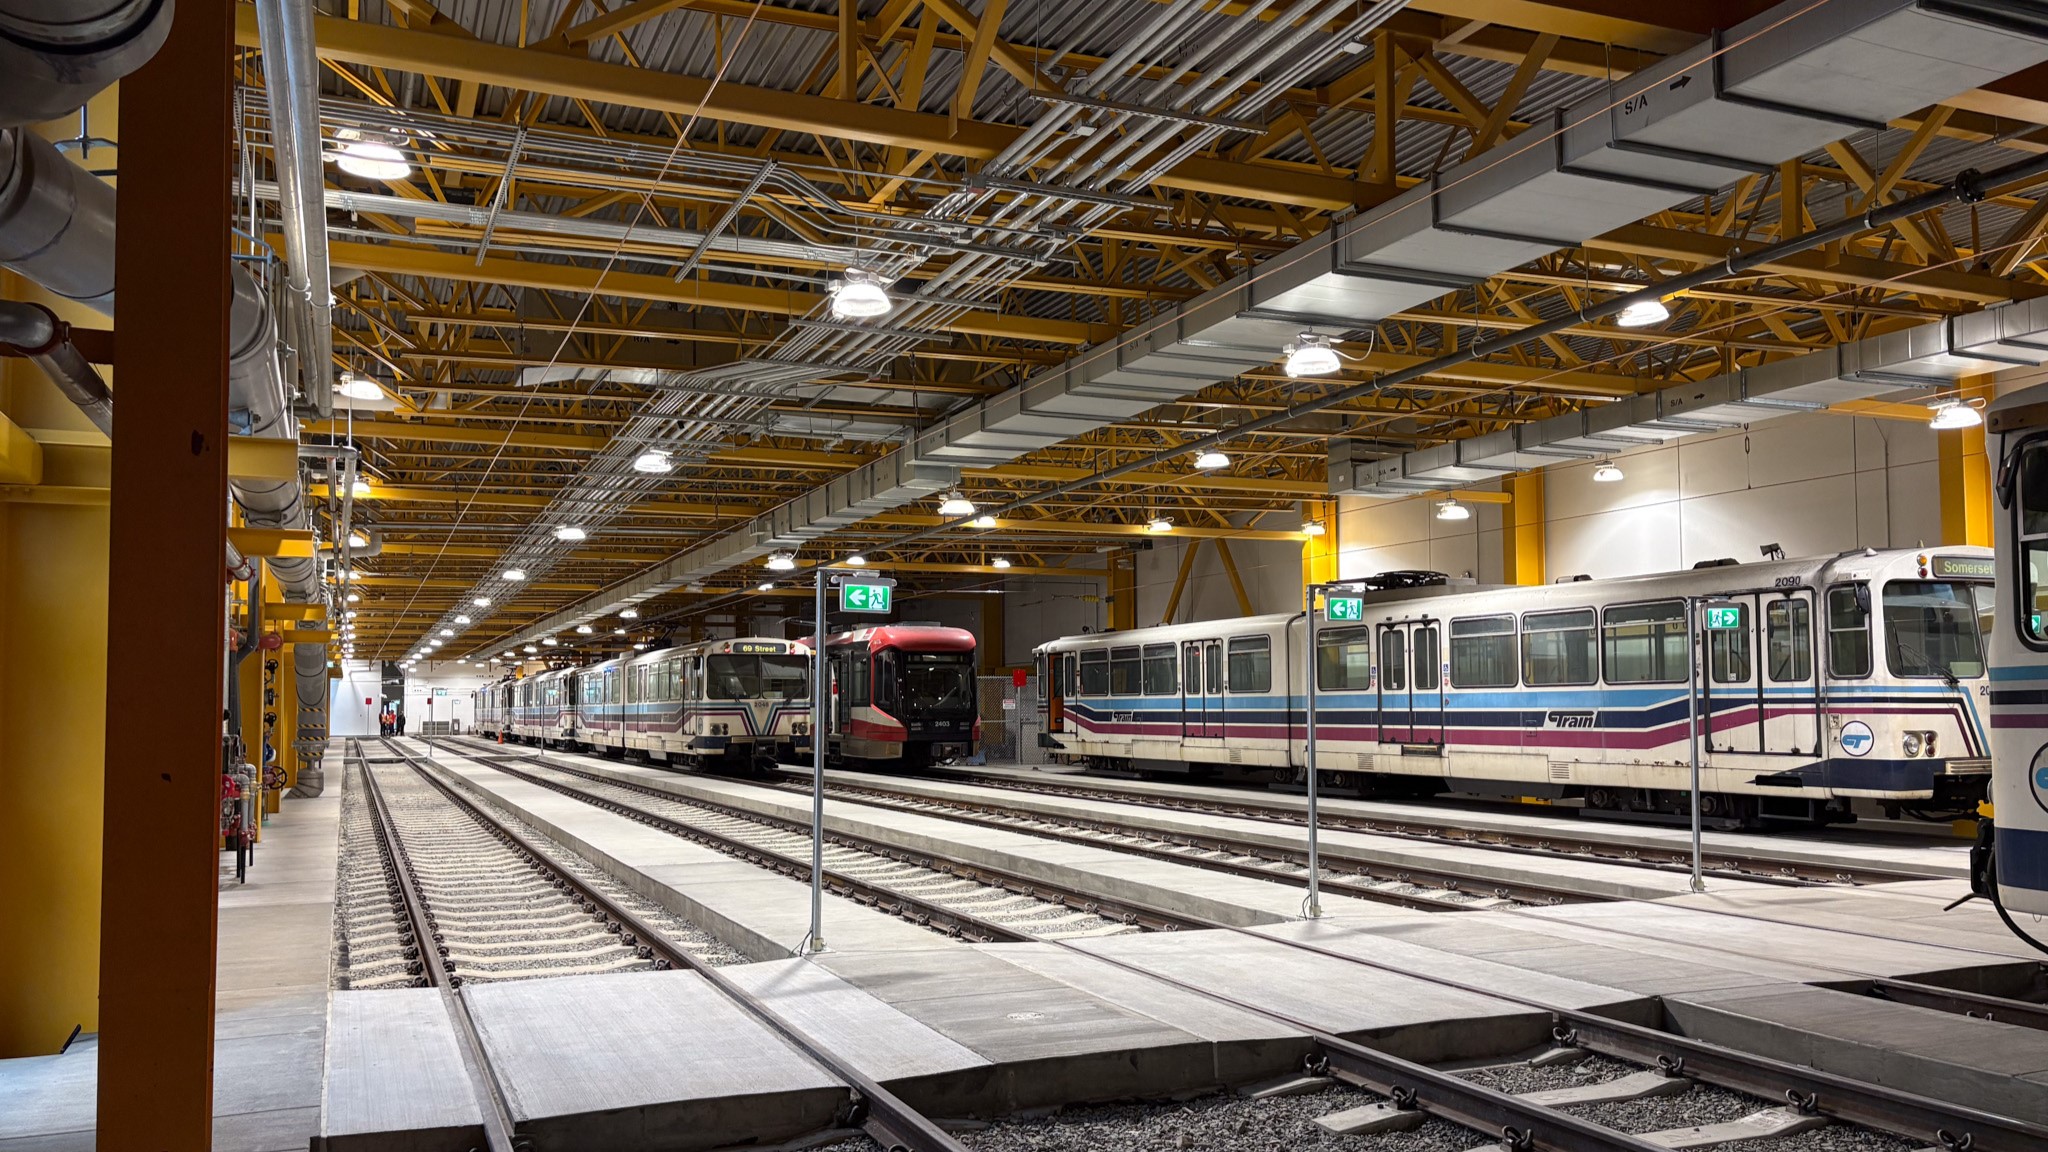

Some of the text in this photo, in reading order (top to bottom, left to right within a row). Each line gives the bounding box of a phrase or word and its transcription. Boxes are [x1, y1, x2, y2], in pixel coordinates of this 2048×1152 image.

[1625, 94, 1648, 115] S/A
[1671, 398, 1683, 407] S/A
[1944, 561, 1993, 575] Somerset
[1775, 576, 1801, 587] 2090
[1980, 685, 1990, 696] 20
